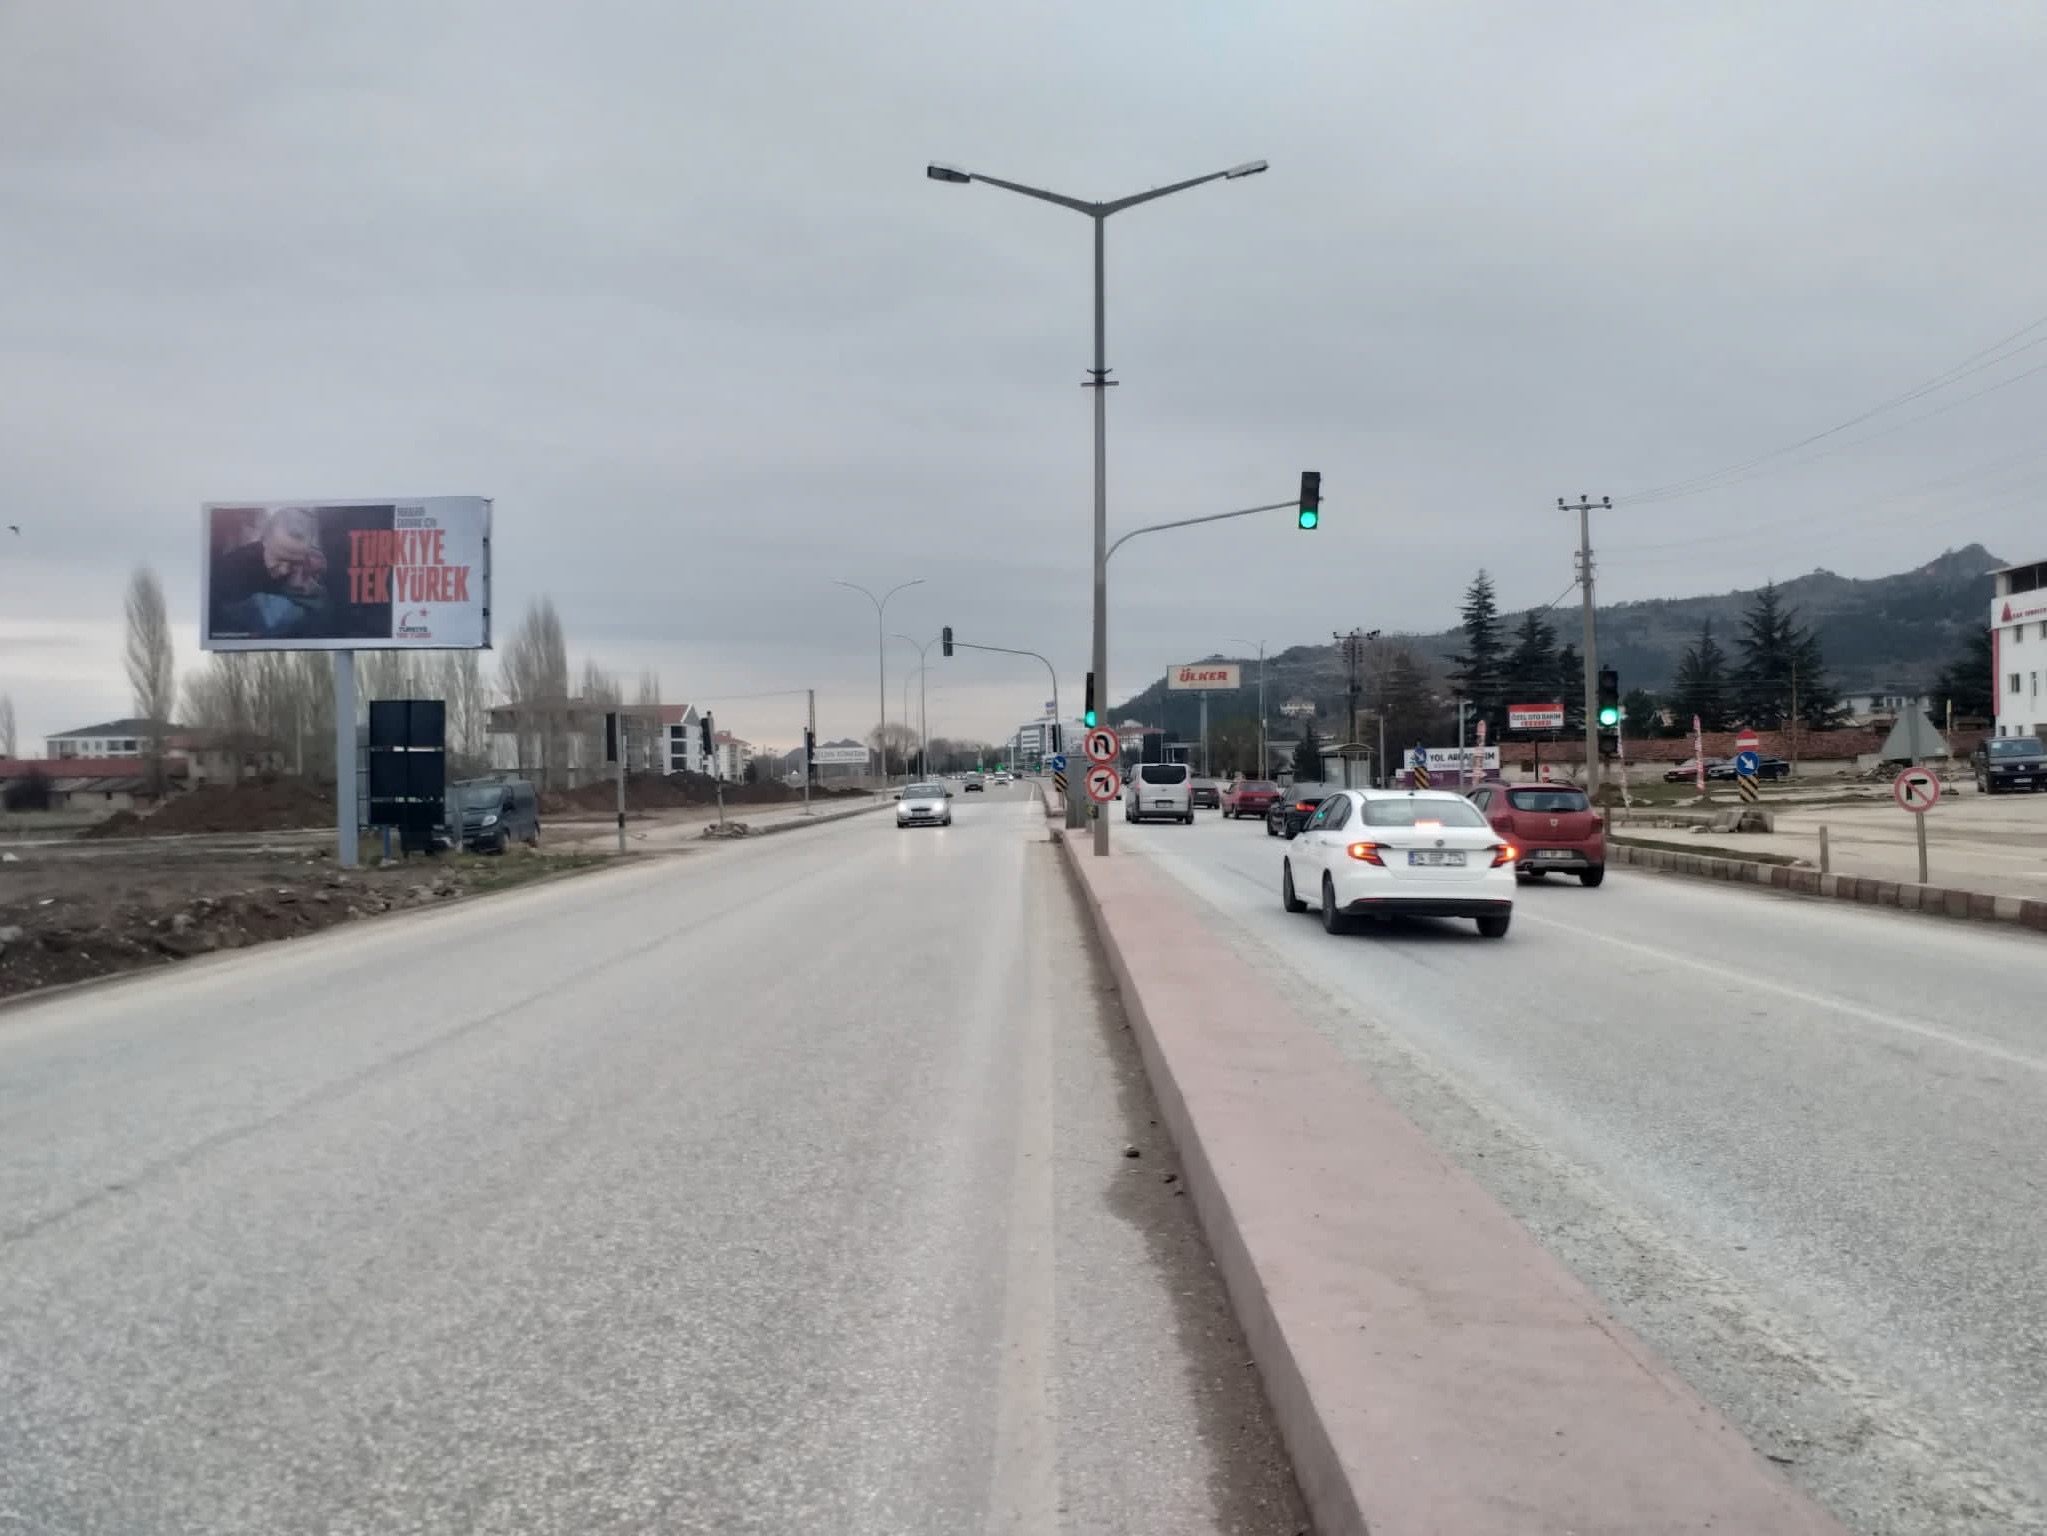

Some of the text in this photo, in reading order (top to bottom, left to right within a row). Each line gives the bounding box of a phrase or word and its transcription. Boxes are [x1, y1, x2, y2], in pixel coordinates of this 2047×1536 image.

[348, 529, 446, 566] TÜRKİYE
[348, 566, 471, 603] TEK YÜREK
[1179, 667, 1228, 682] ÜLKER
[1430, 753, 1446, 762] YOL
